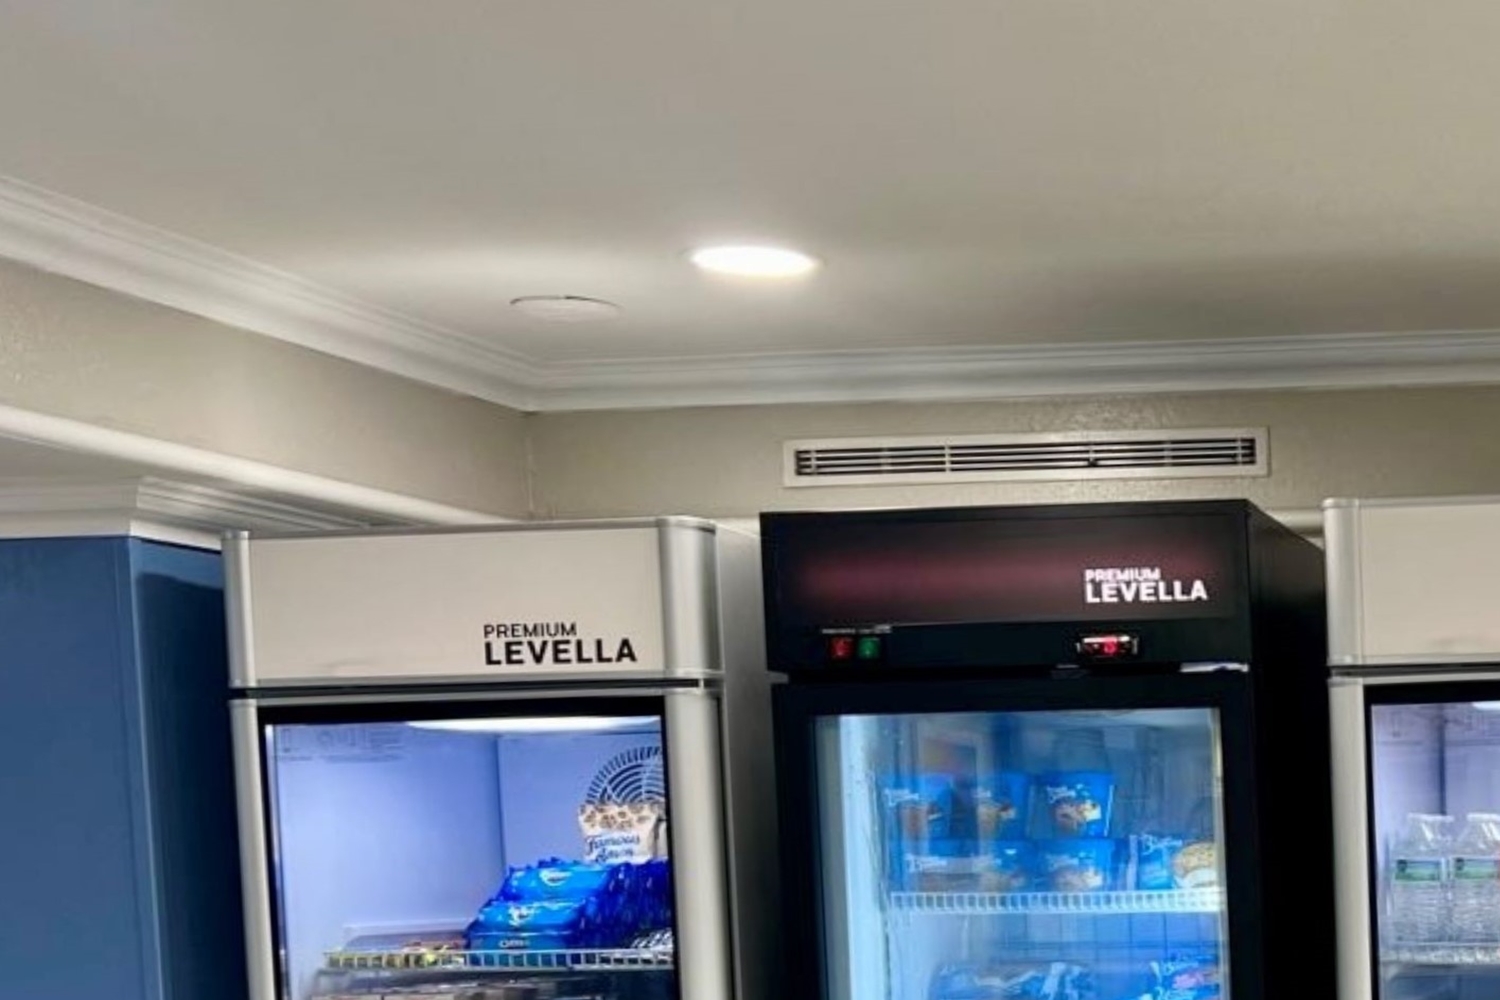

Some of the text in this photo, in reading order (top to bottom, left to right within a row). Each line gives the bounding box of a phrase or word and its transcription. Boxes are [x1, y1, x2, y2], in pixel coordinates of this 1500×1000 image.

[1085, 567, 1161, 582] PREMIUM
[1086, 580, 1208, 603] LEVELLA
[483, 622, 577, 639] PREMIUM
[484, 638, 638, 665] LEVELLA
